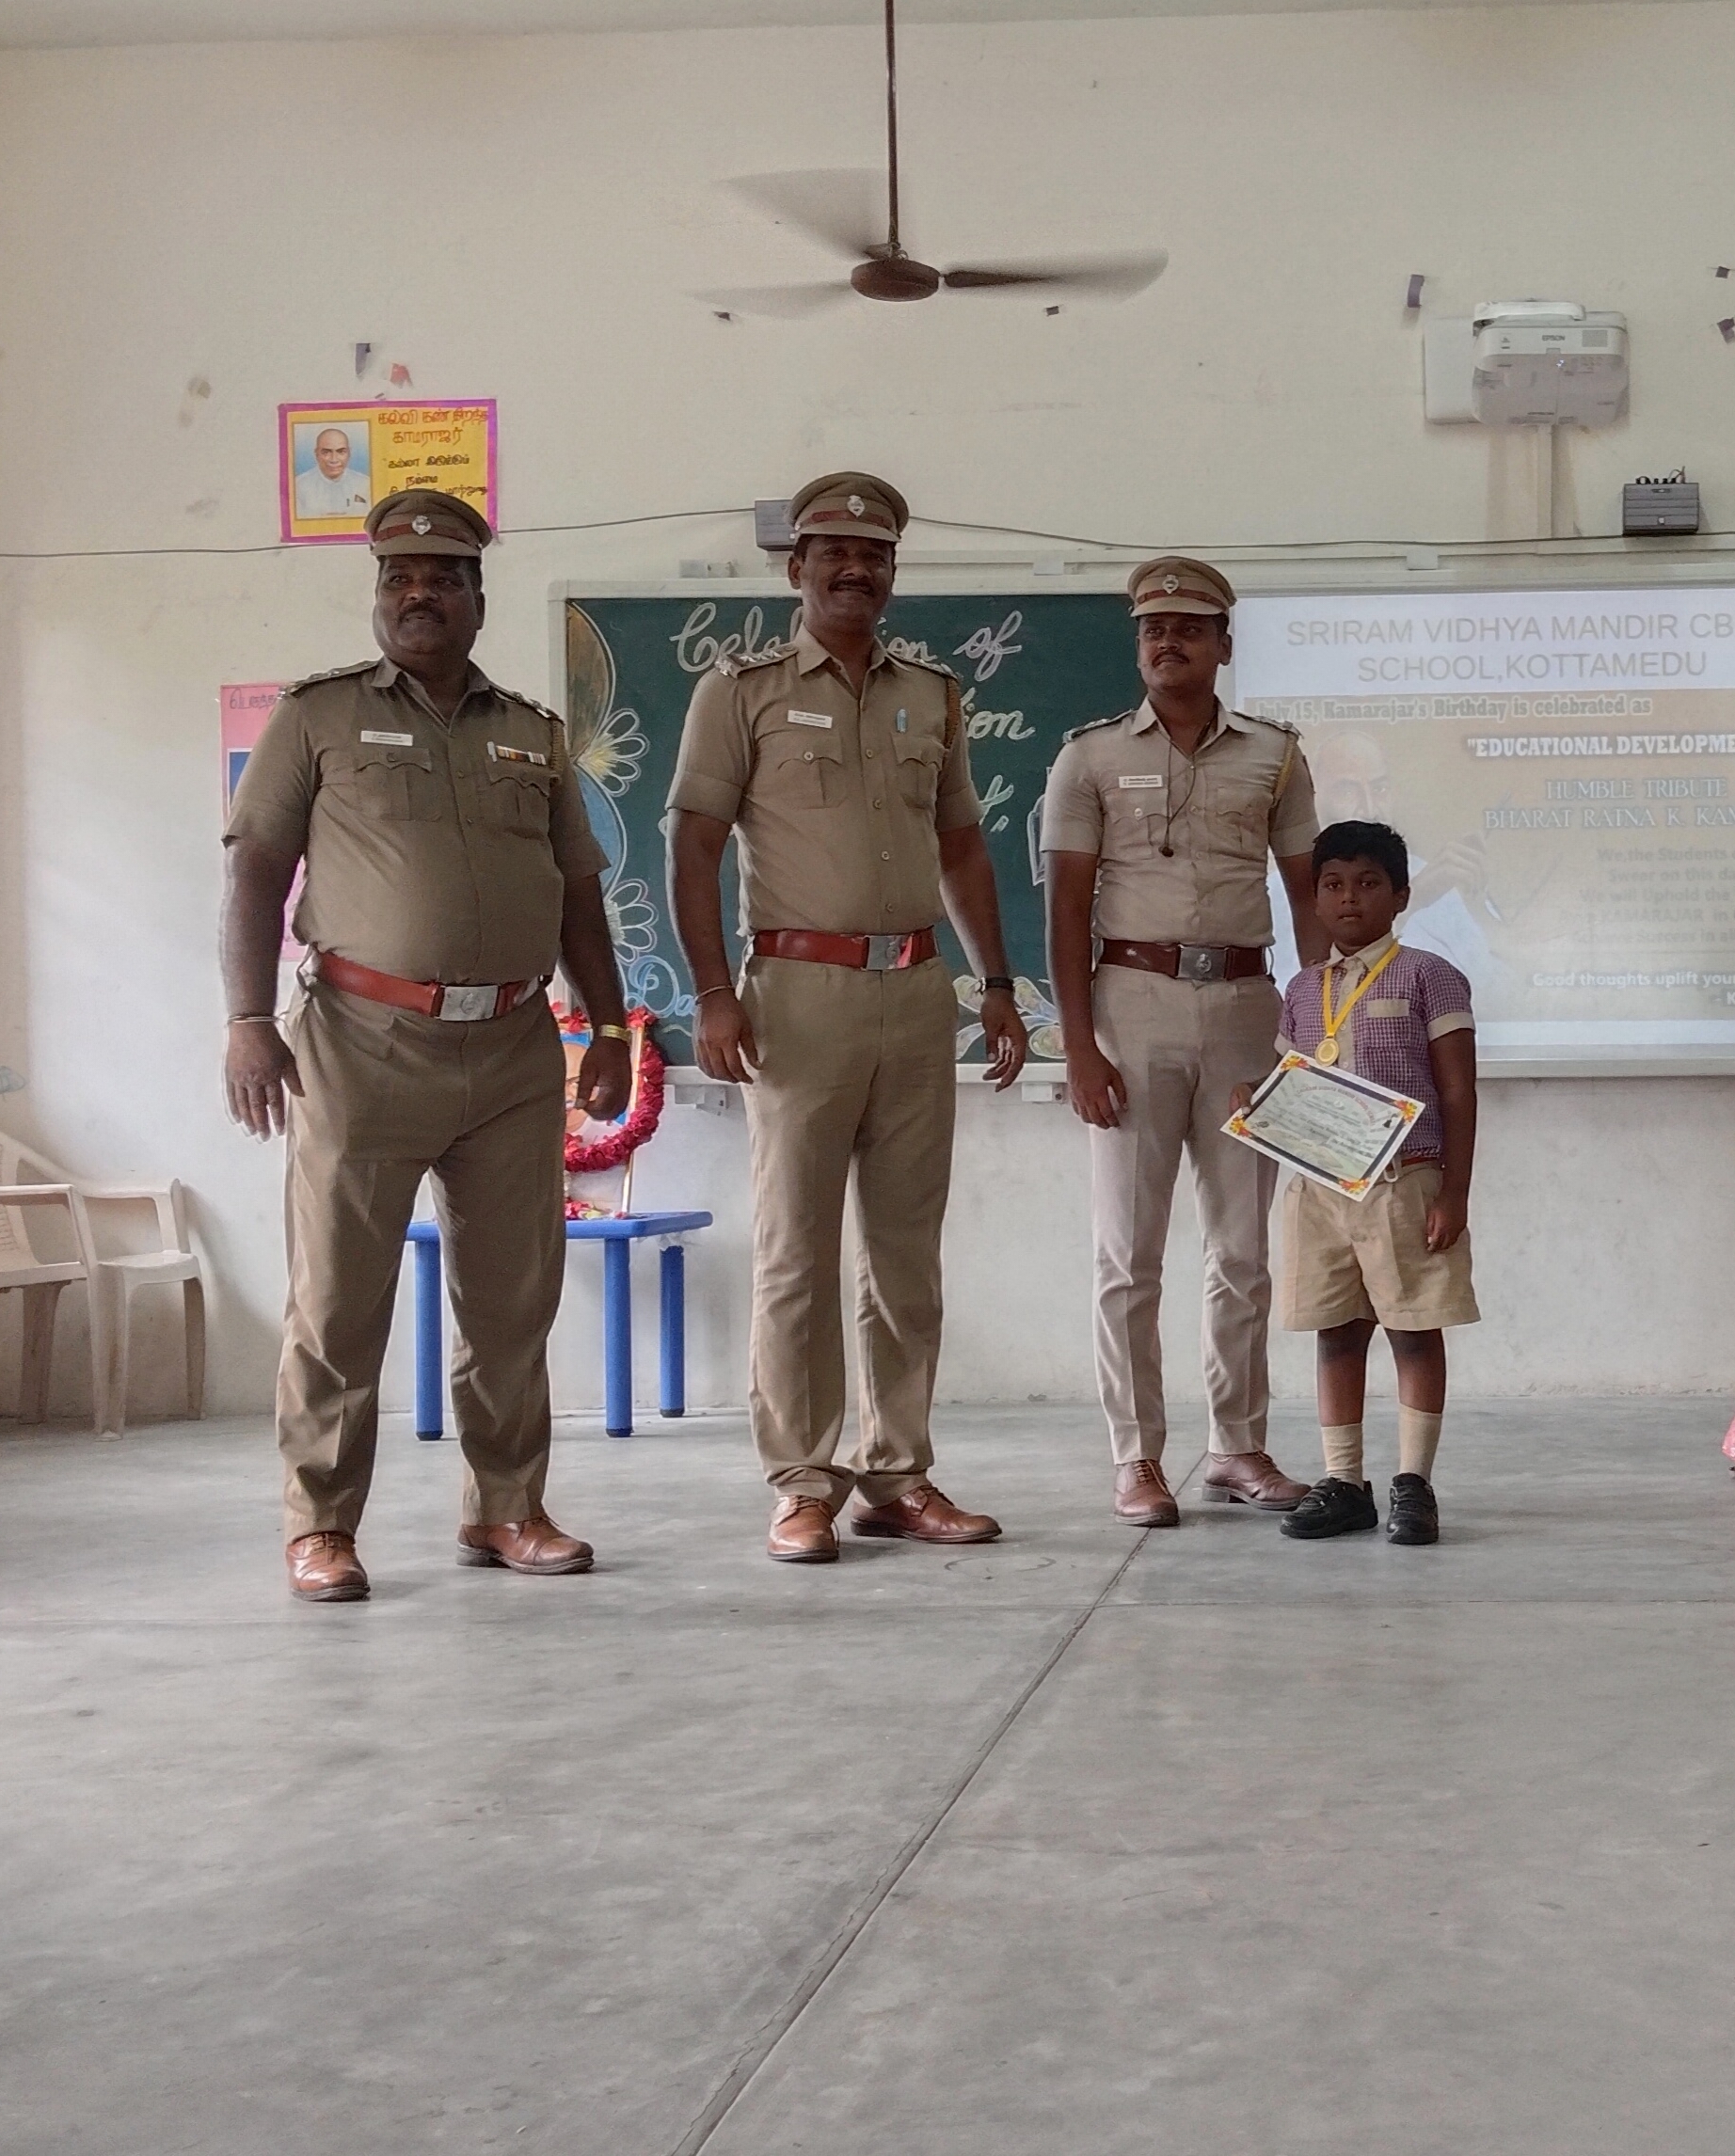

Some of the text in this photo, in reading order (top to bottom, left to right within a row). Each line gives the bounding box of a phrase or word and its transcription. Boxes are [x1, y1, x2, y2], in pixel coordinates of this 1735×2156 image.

[1287, 619, 1413, 646] SRIRAM
[1423, 616, 1541, 643] VIDHYA
[1553, 613, 1679, 642] MANDIR
[953, 610, 1023, 682] of
[1358, 652, 1707, 683] SCHOOL,KOTTAMEDU
[1323, 700, 1426, 722] Kamarajar's
[1433, 697, 1507, 721] Birthday
[1514, 696, 1528, 717] is
[1534, 694, 1626, 716] celebrated
[1632, 698, 1651, 715] as
[1467, 737, 1613, 756] "EDUCATIONAL
[1546, 778, 1727, 800] HUMBLE TRIBUTE
[1485, 809, 1571, 829] BHARAT
[1583, 807, 1657, 827] RATNA
[1658, 847, 1727, 860] Students
[1580, 973, 1650, 990] thoughts
[1656, 971, 1698, 988] uplift
